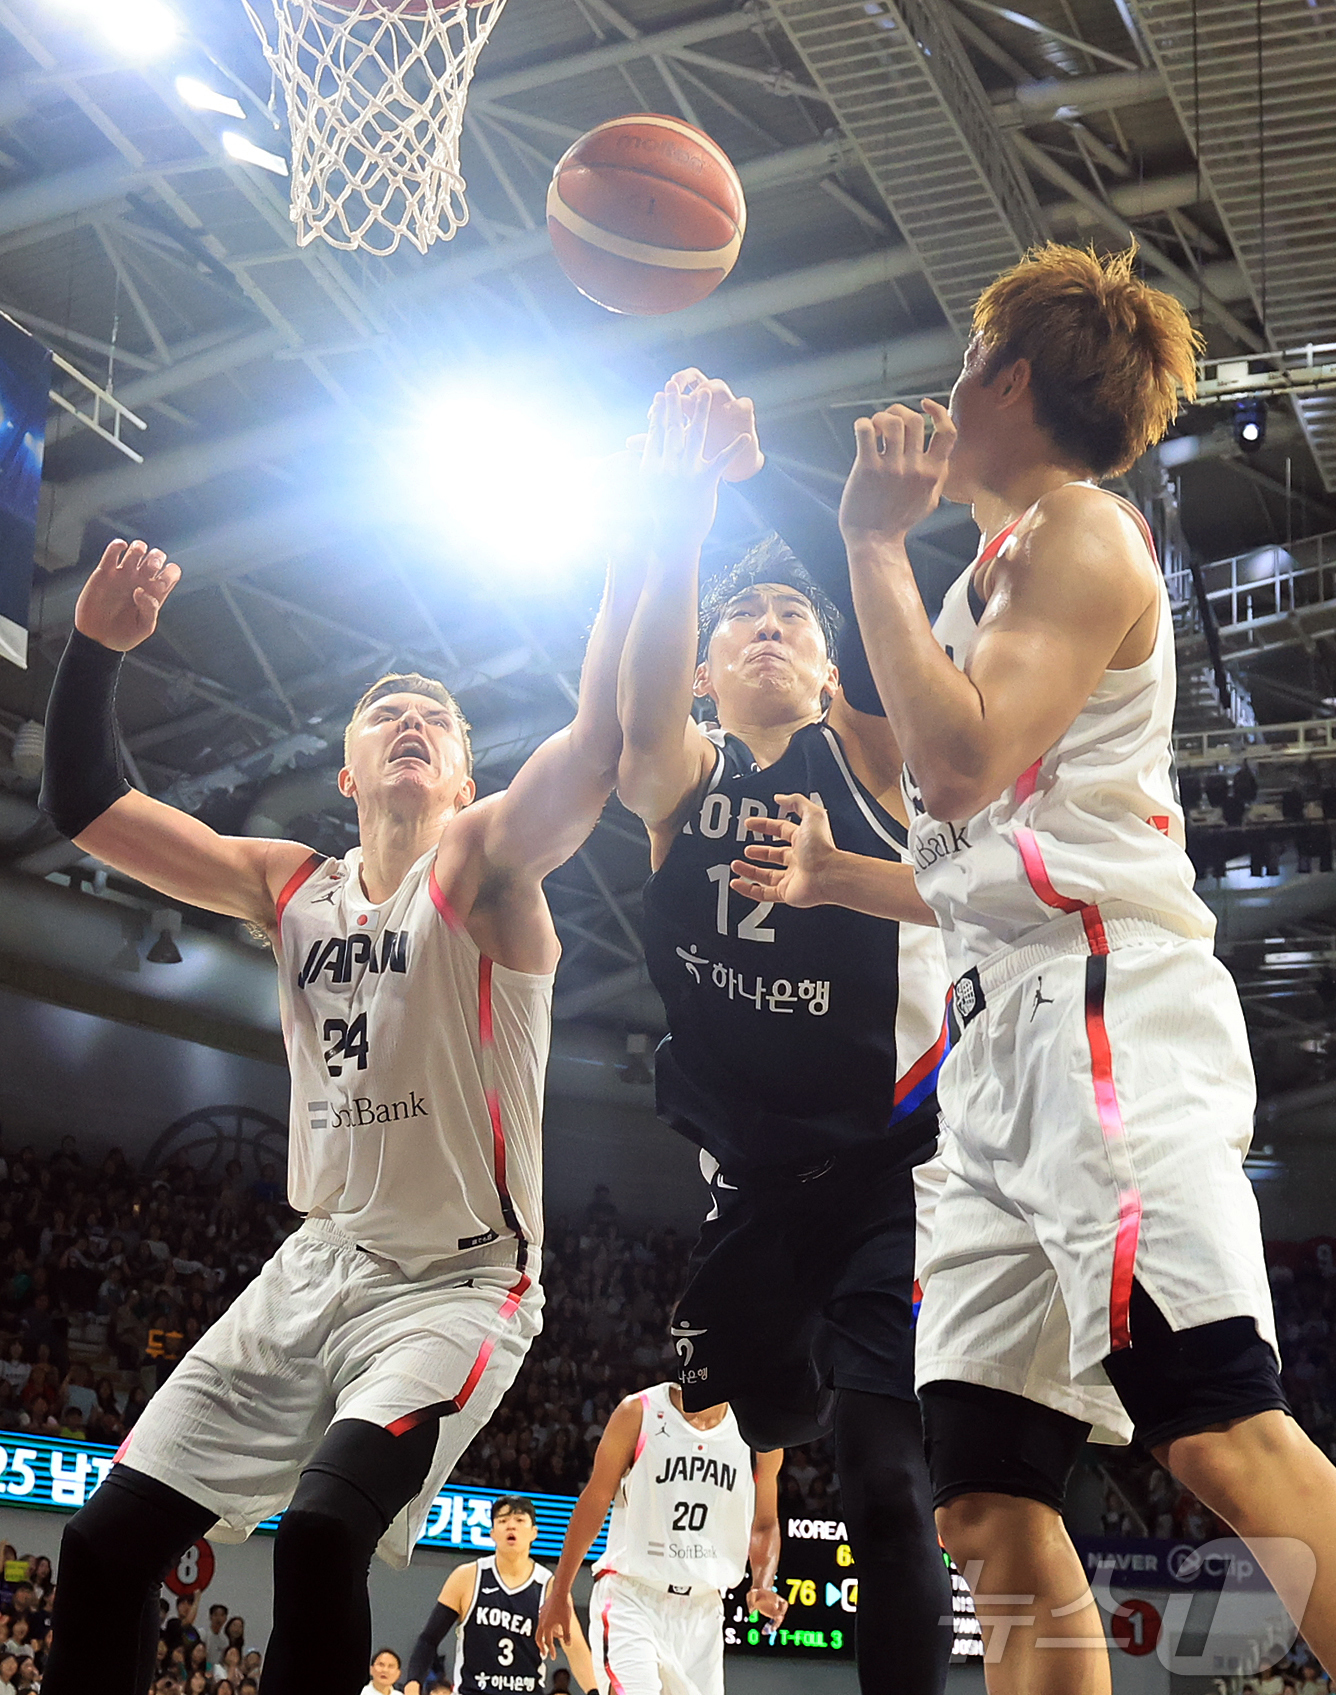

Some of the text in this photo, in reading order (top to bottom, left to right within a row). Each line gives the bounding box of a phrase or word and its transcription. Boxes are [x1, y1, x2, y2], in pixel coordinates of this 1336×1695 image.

[298, 929, 409, 989] JAPAN
[712, 962, 831, 1016] 하나은행
[323, 1011, 369, 1078] 24
[655, 1456, 737, 1493] JAPAN
[416, 1495, 497, 1549] 가전
[672, 1501, 708, 1532] 20
[788, 1518, 848, 1541] KOREA
[177, 1545, 199, 1585] 8
[668, 1543, 718, 1559] SoftBank
[836, 1544, 855, 1567] 6
[1087, 1552, 1255, 1583] NAVER Clip
[785, 1578, 817, 1607] 76
[476, 1606, 533, 1637] KOREA
[1128, 1610, 1144, 1646] 1
[497, 1637, 515, 1667] 3
[779, 1629, 843, 1650] T-FOUL 3
